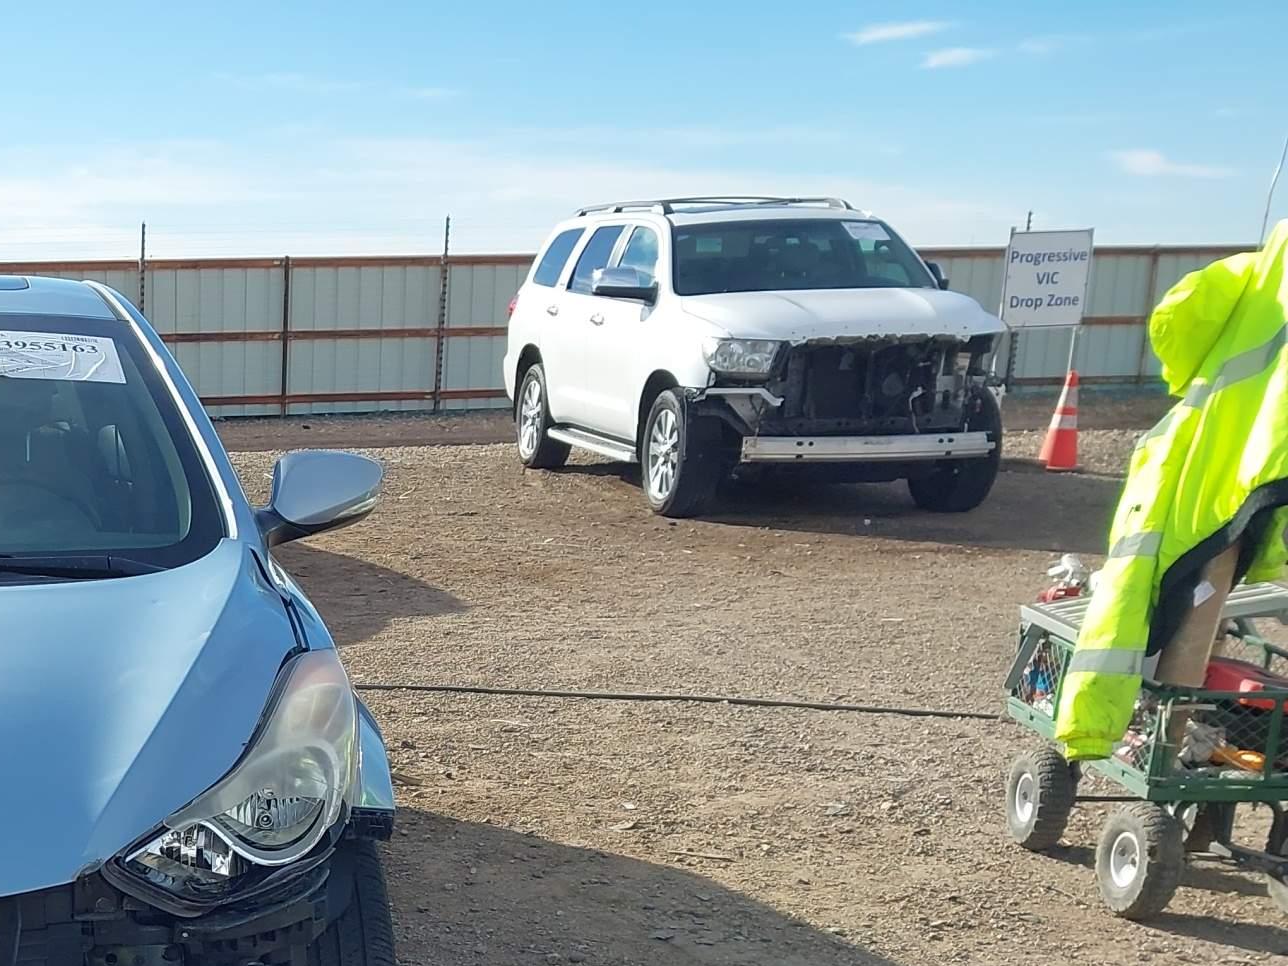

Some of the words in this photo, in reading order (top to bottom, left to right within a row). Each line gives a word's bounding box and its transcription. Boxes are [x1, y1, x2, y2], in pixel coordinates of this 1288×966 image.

[1010, 249, 1088, 266] Progressive
[1036, 271, 1060, 285] VIC
[1010, 295, 1043, 311] Drop
[1047, 294, 1080, 307] Zone
